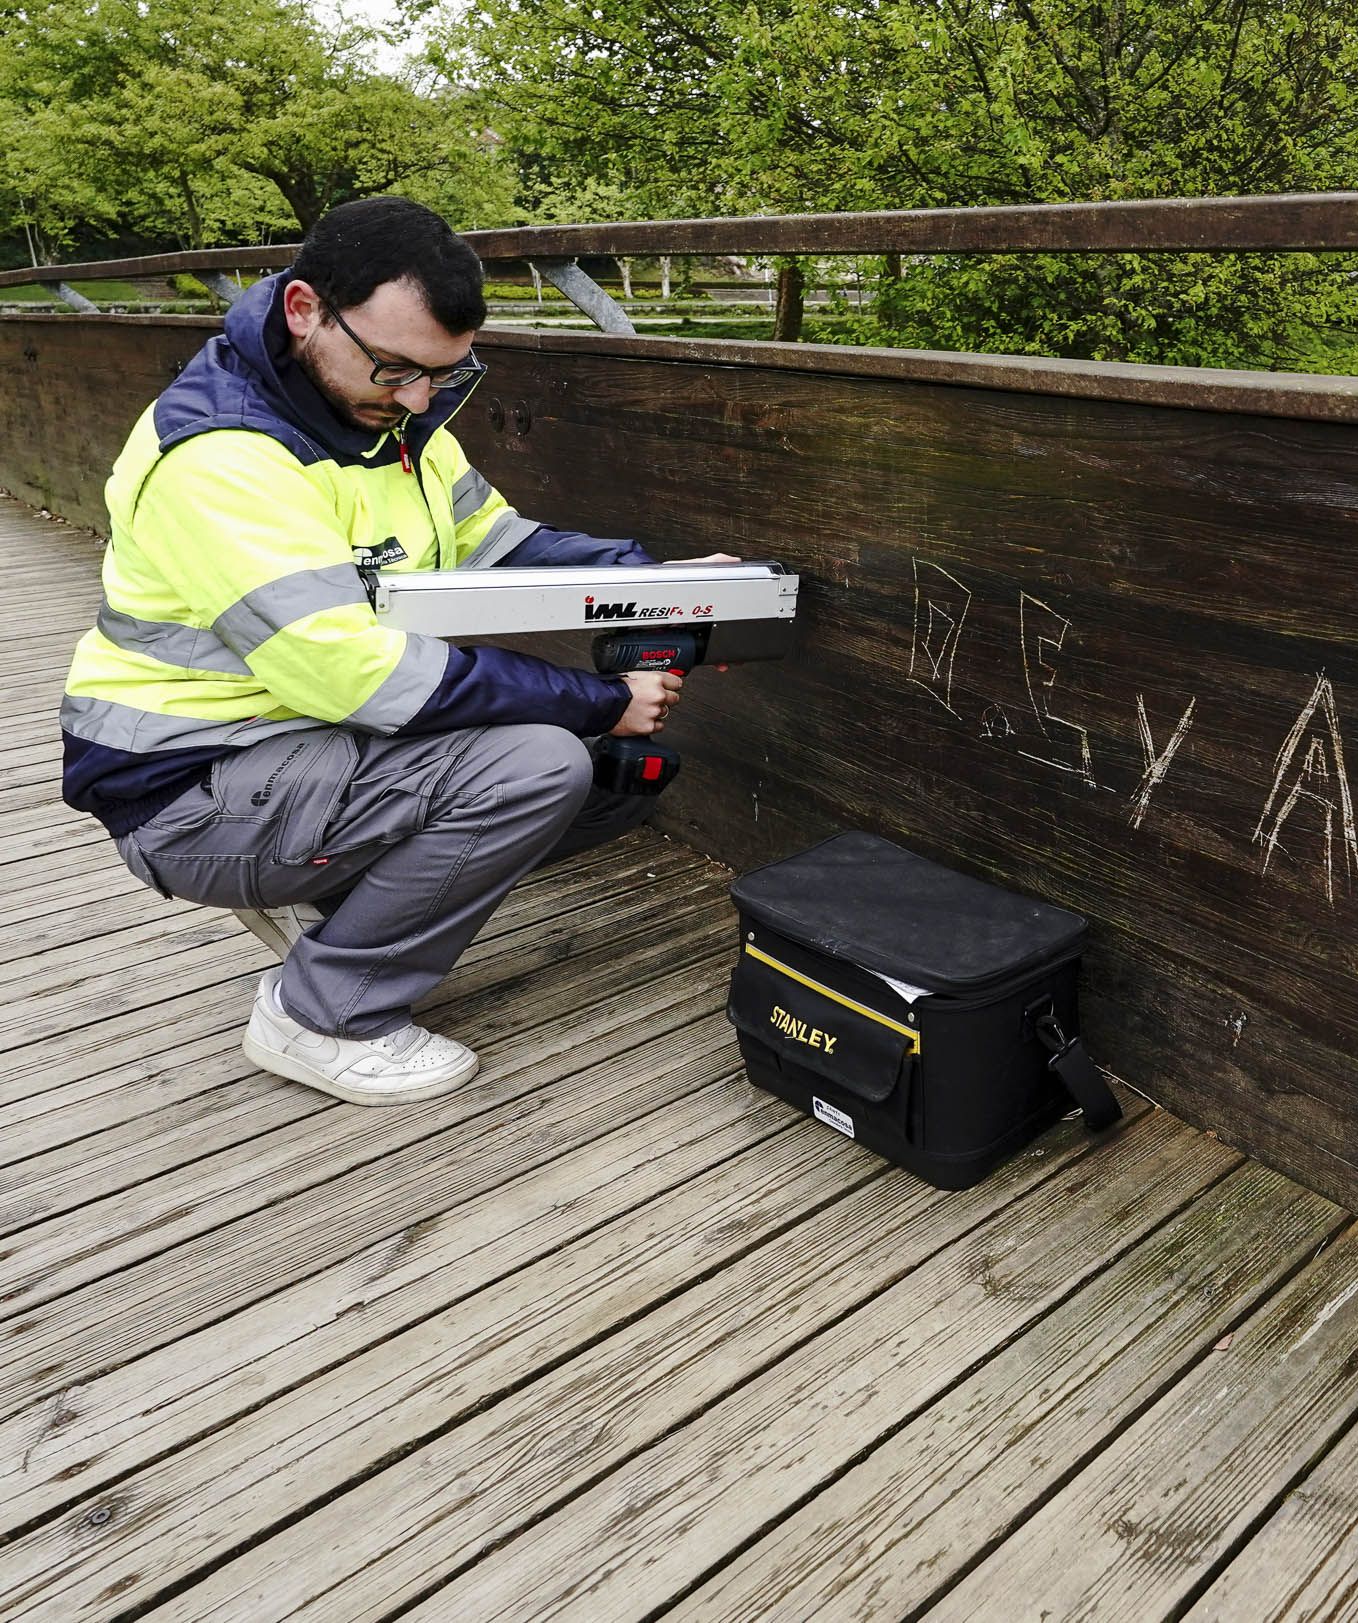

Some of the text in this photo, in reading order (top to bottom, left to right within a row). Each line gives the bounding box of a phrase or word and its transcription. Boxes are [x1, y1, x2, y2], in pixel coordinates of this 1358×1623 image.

[642, 649, 676, 661] BOSCH
[262, 743, 305, 797] enmacosa
[770, 1005, 837, 1053] STANLEY
